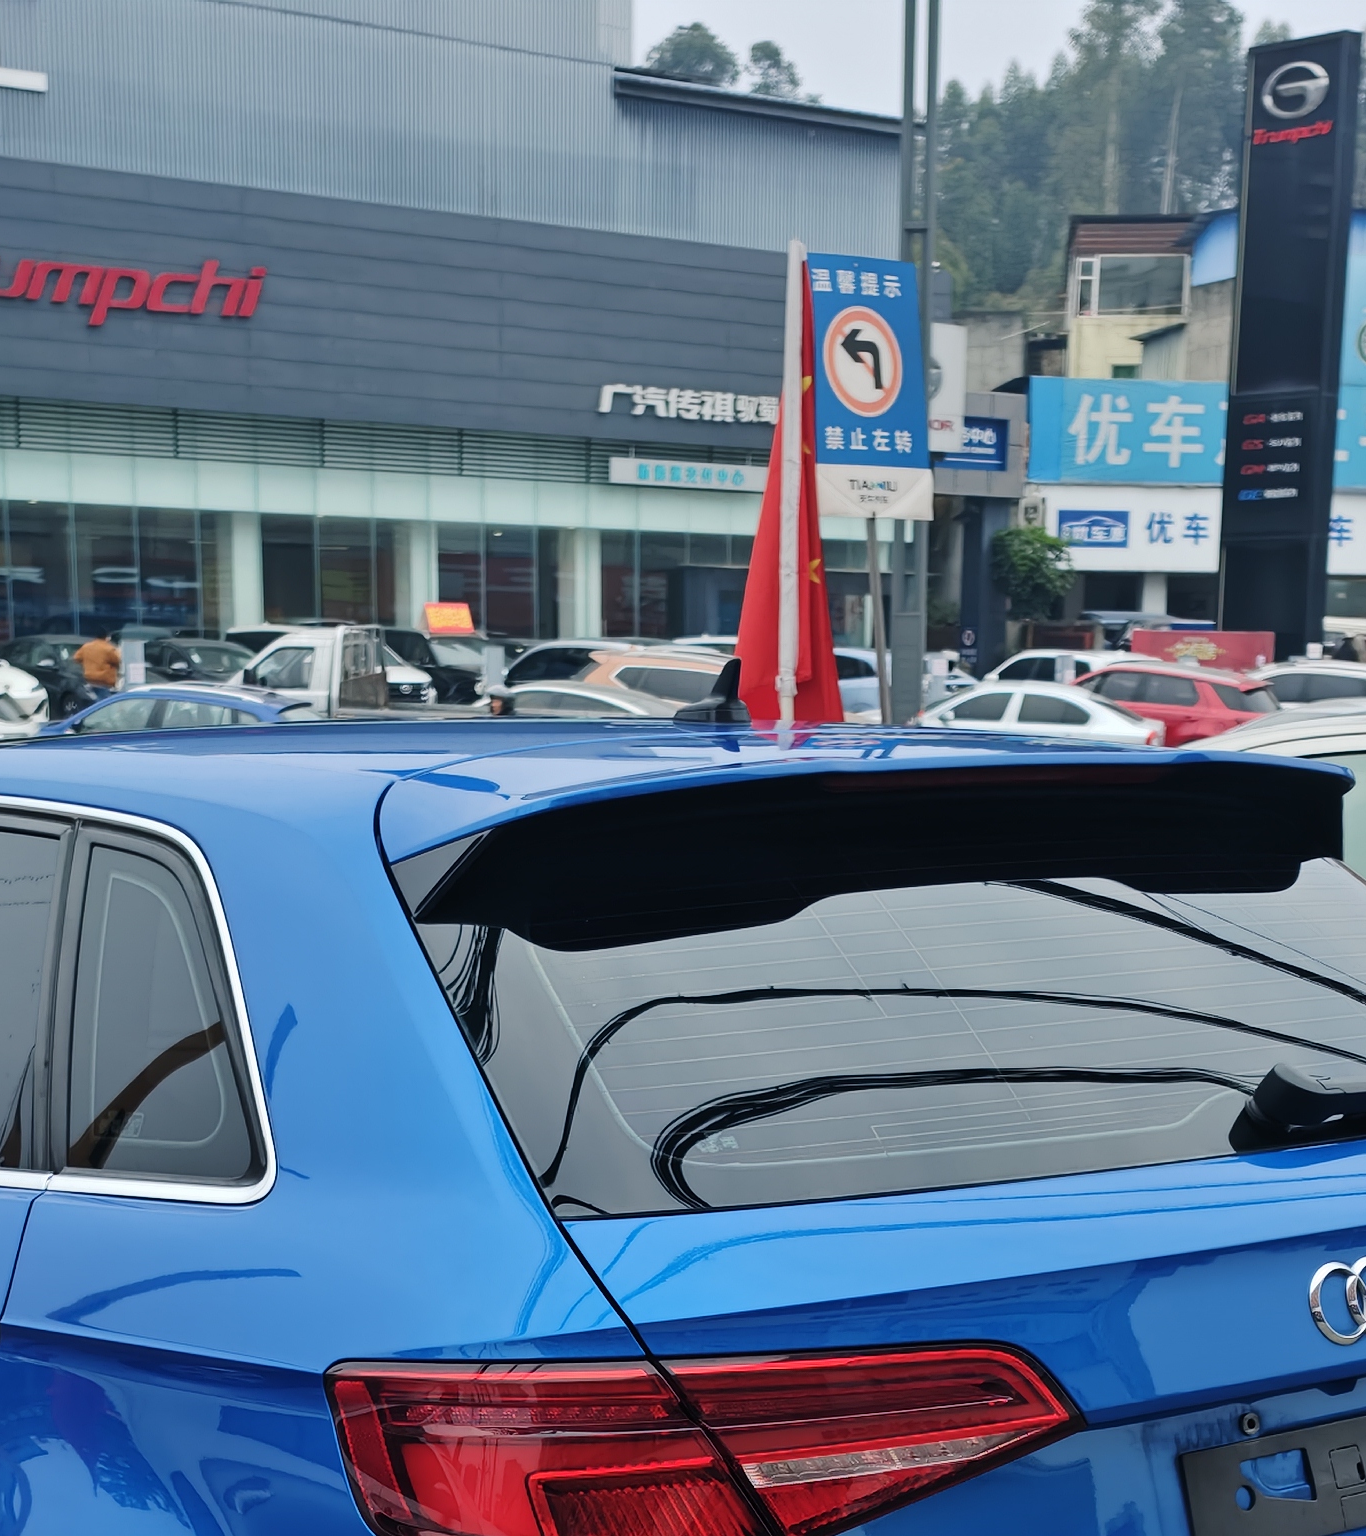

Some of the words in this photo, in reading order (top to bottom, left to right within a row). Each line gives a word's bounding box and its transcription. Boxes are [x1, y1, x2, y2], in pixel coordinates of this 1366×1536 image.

[811, 268, 902, 298] 温馨提示
[824, 426, 913, 454] 禁止左转
